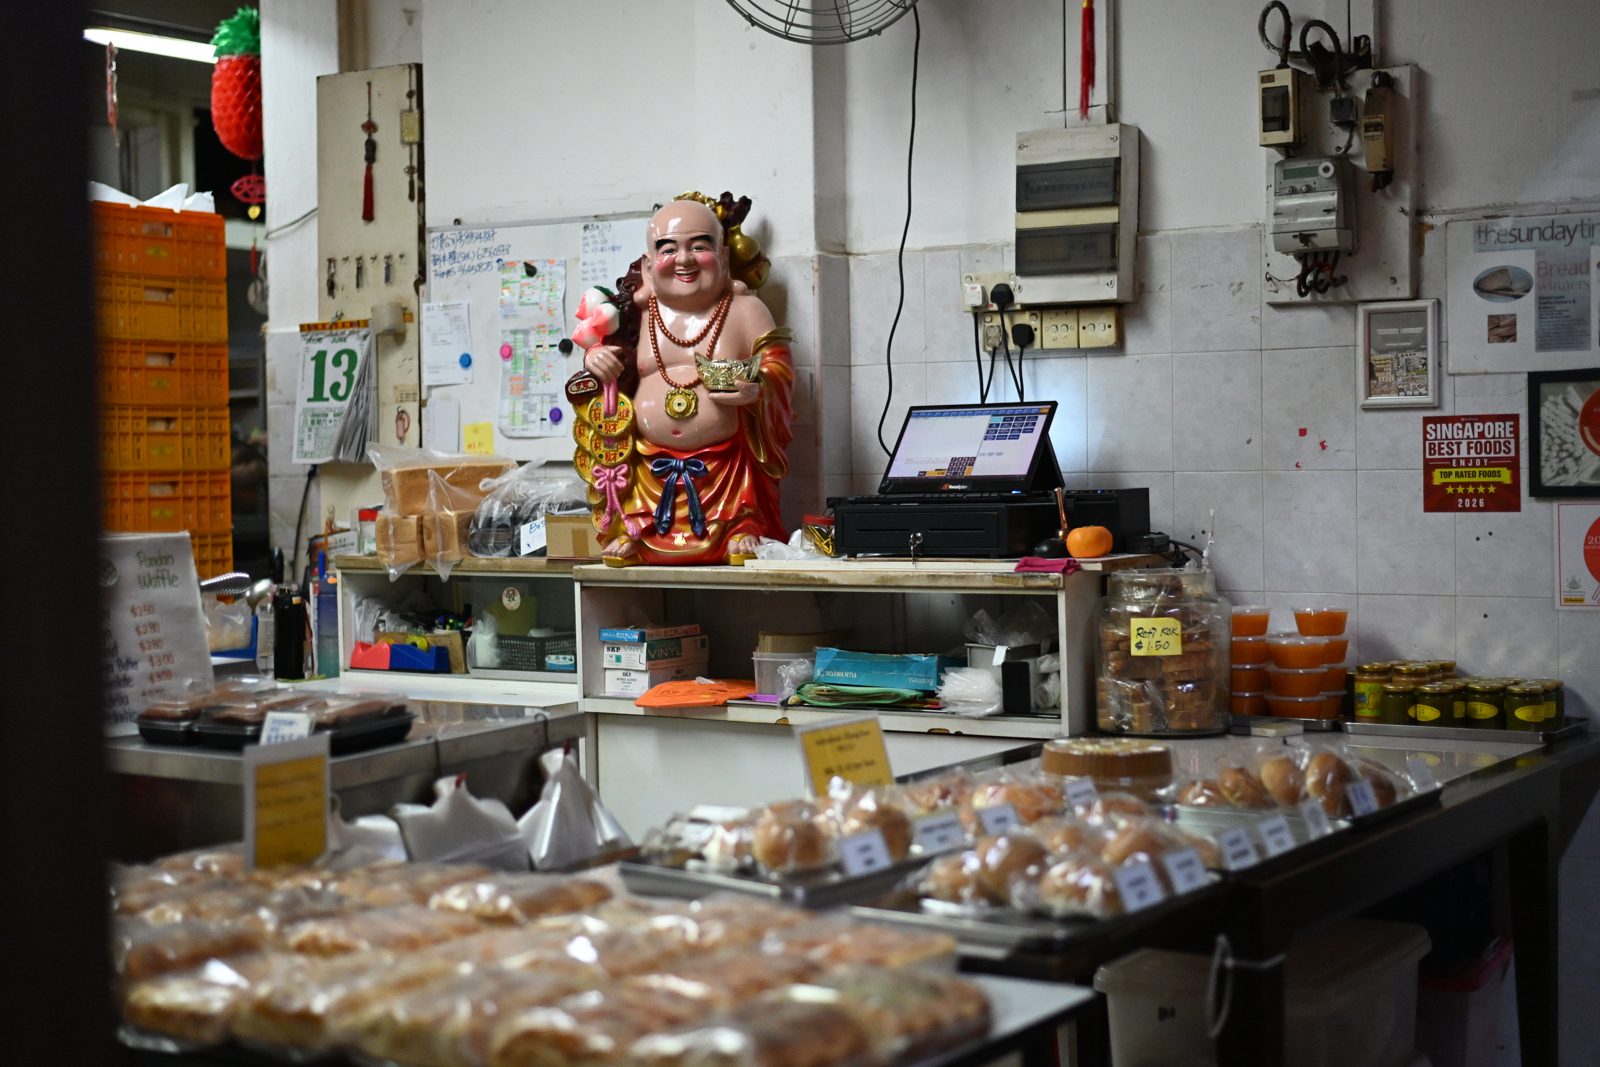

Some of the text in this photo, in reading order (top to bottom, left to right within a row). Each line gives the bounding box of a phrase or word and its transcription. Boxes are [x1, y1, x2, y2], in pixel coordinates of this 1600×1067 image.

[1537, 258, 1591, 277] Bread
[1537, 280, 1591, 291] winners
[307, 348, 358, 402] 13
[1426, 422, 1514, 440] SINGAPORE
[1428, 440, 1512, 456] BEST FOODS
[1452, 459, 1489, 467] ENJOY
[1454, 470, 1477, 478] RATED
[1478, 470, 1501, 478] FOODS
[1457, 498, 1485, 508] 2026
[136, 550, 175, 567] Pandan
[138, 568, 180, 590] Waffle
[648, 647, 683, 658] VINYL
[908, 676, 934, 686] Business
